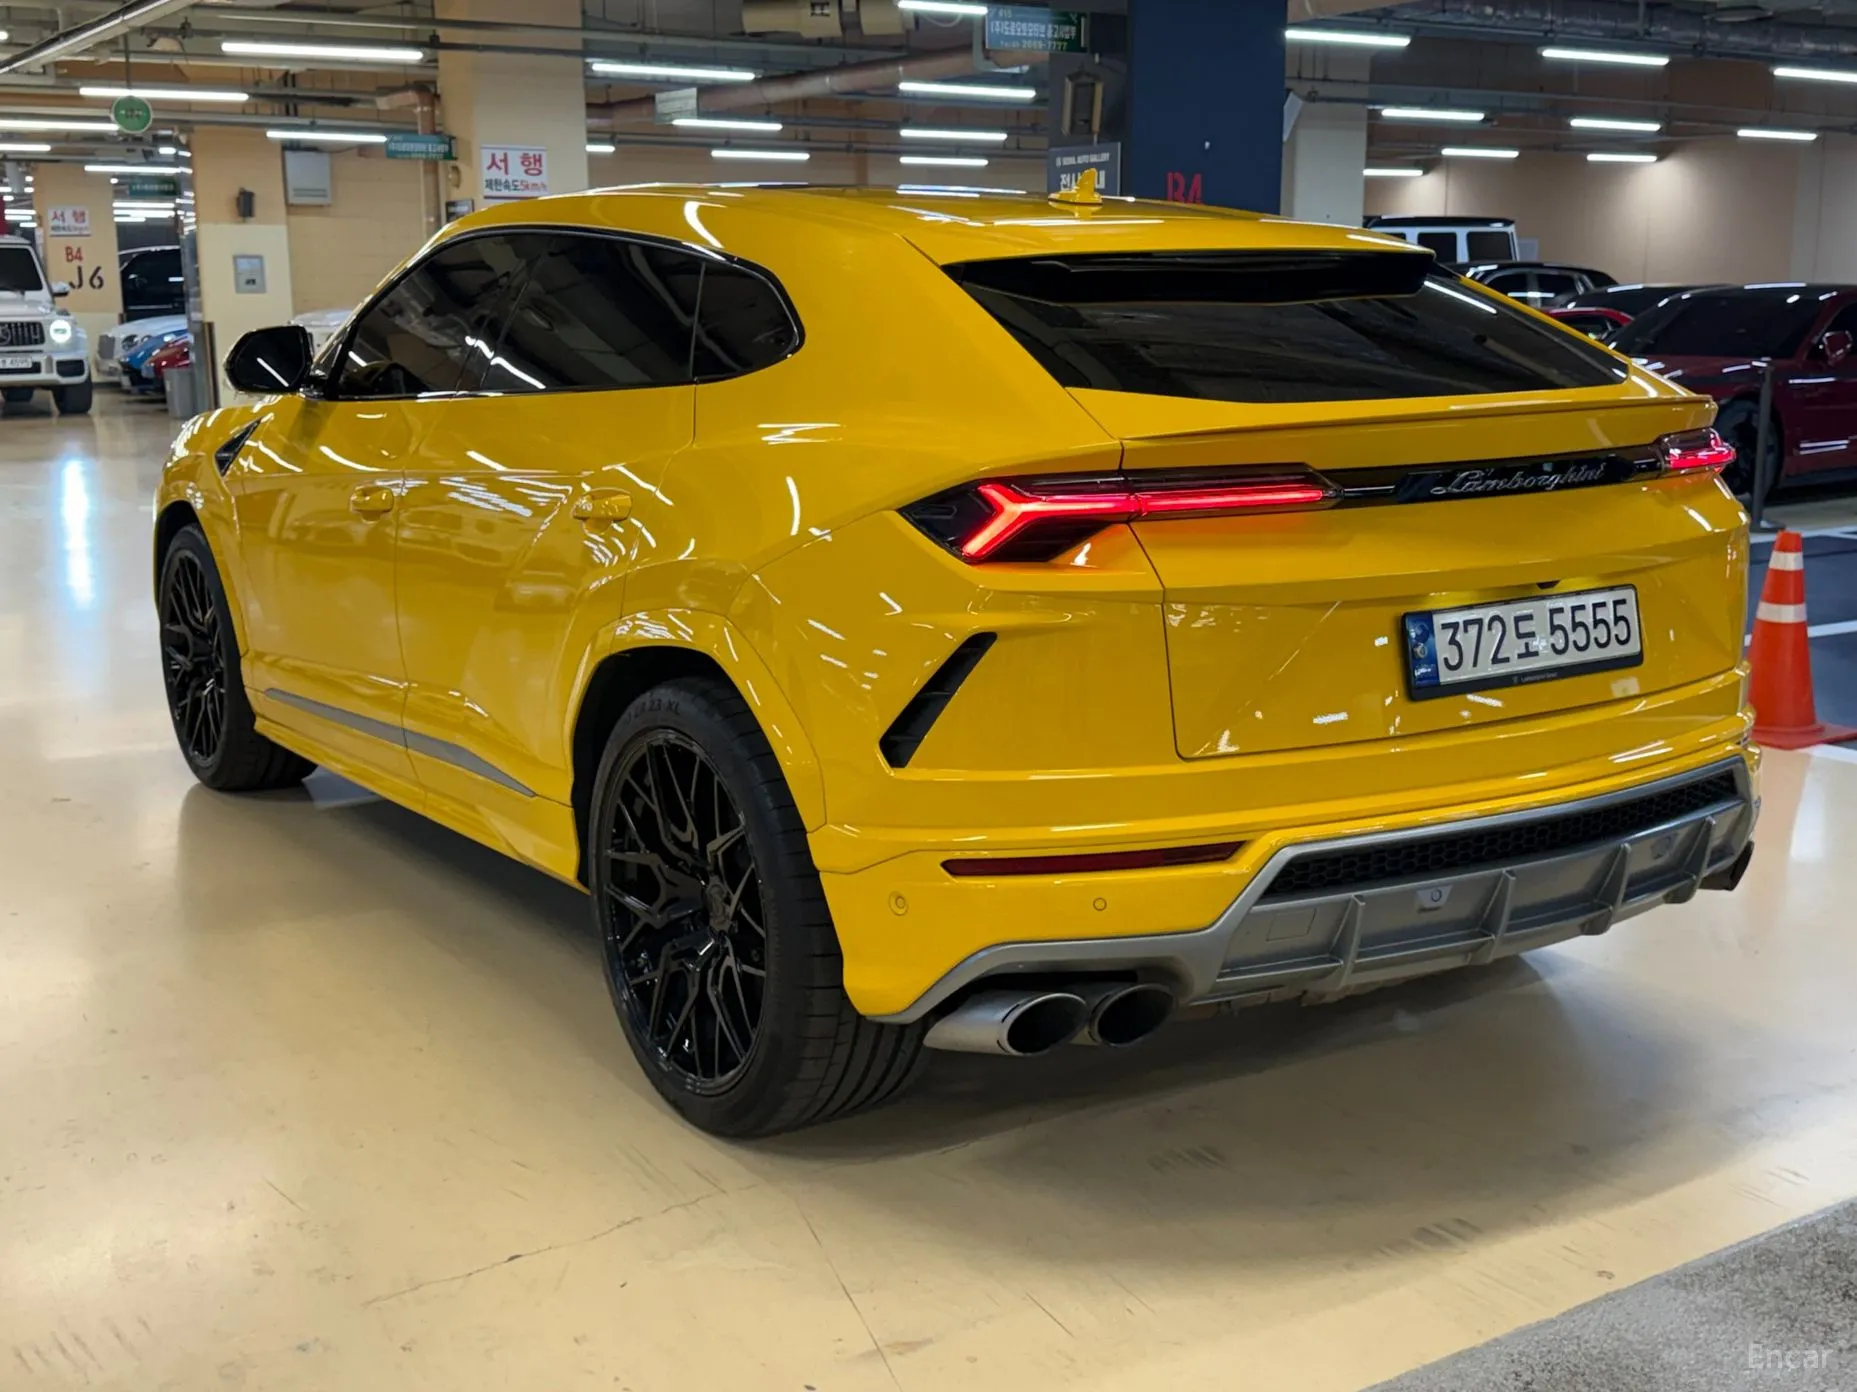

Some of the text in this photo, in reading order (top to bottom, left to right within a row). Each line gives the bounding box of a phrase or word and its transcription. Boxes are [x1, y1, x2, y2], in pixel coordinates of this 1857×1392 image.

[64, 245, 83, 263] B4
[1429, 461, 1607, 496] Lamborghini
[1548, 598, 1632, 656] 5555
